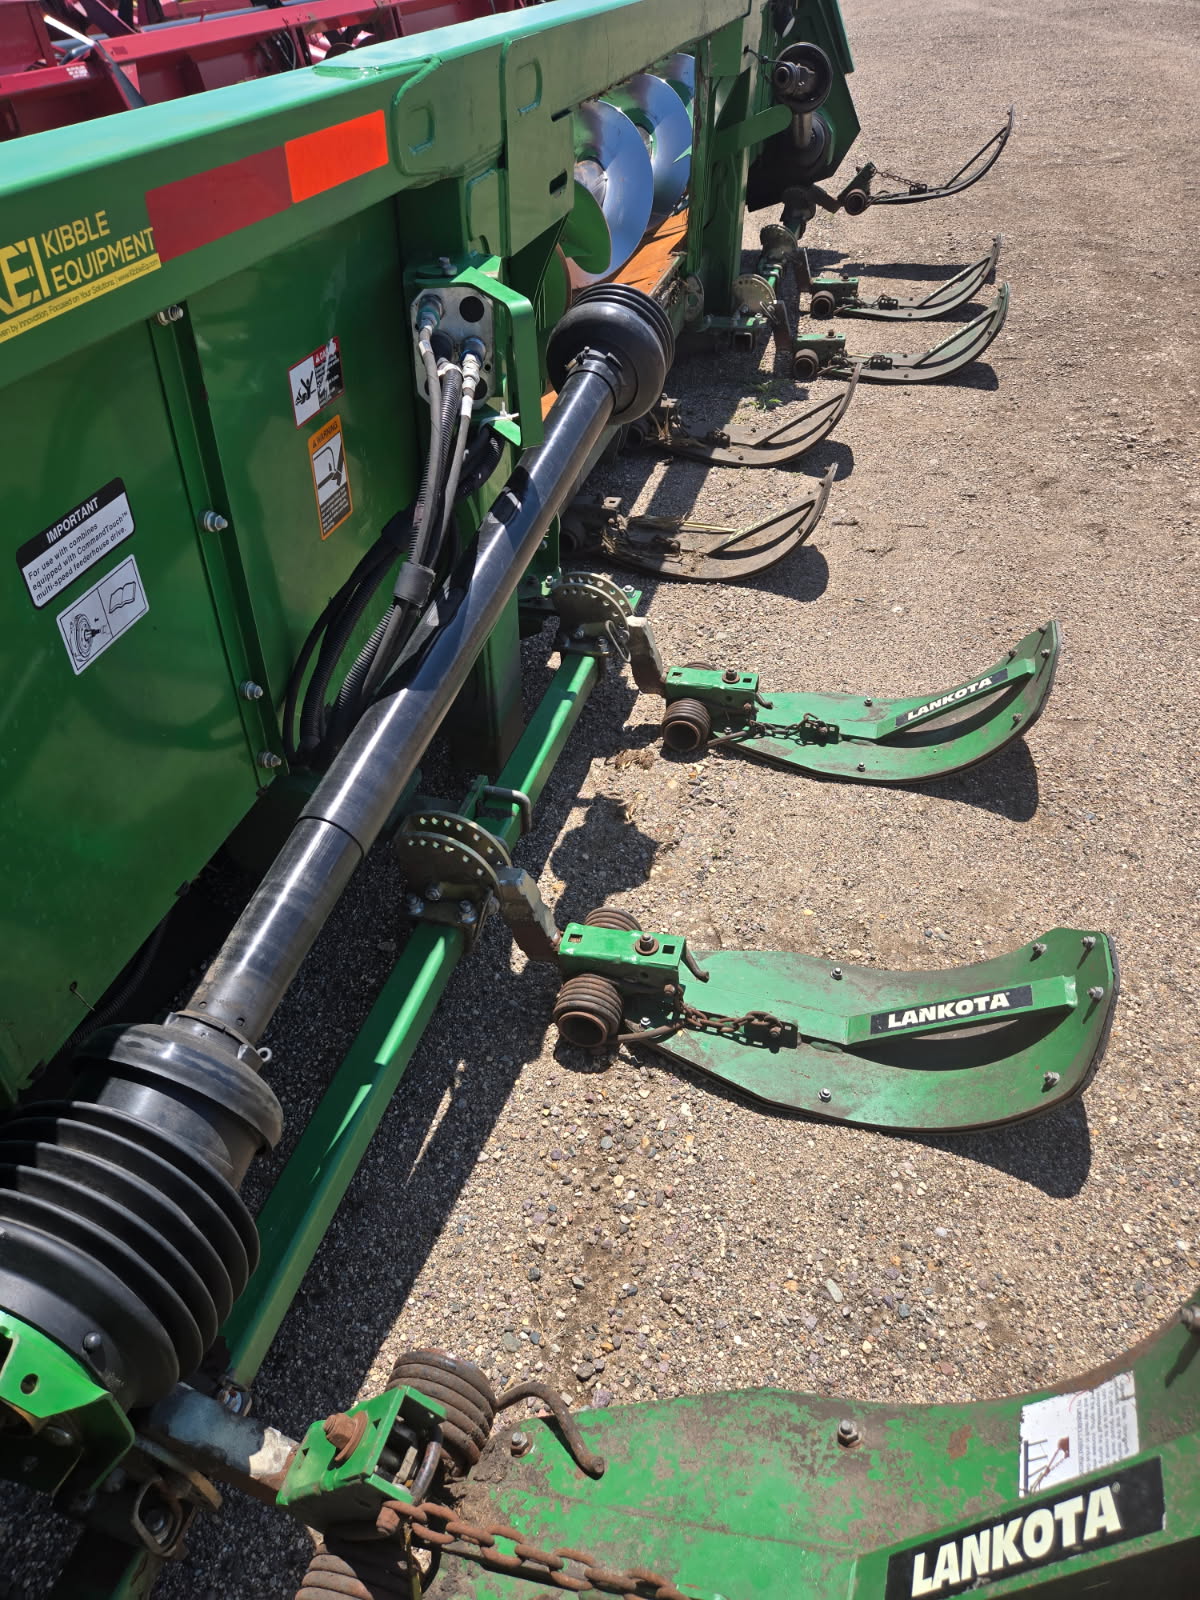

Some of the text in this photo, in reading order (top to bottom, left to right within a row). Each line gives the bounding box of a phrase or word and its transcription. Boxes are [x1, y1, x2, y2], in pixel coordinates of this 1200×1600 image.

[41, 210, 110, 258] KIBBLE
[50, 227, 153, 292] EQUIPMENT
[48, 298, 73, 314] Focused
[72, 295, 80, 304] on
[79, 288, 91, 299] Your
[46, 497, 98, 543] IMPORTANT
[28, 523, 98, 580] For use with combines
[32, 565, 62, 590] equipped
[63, 554, 77, 567] with
[36, 527, 127, 601] multi-speed feederhouse drive.
[907, 677, 993, 720] LANKOTA
[888, 992, 1010, 1029] LANKOTA
